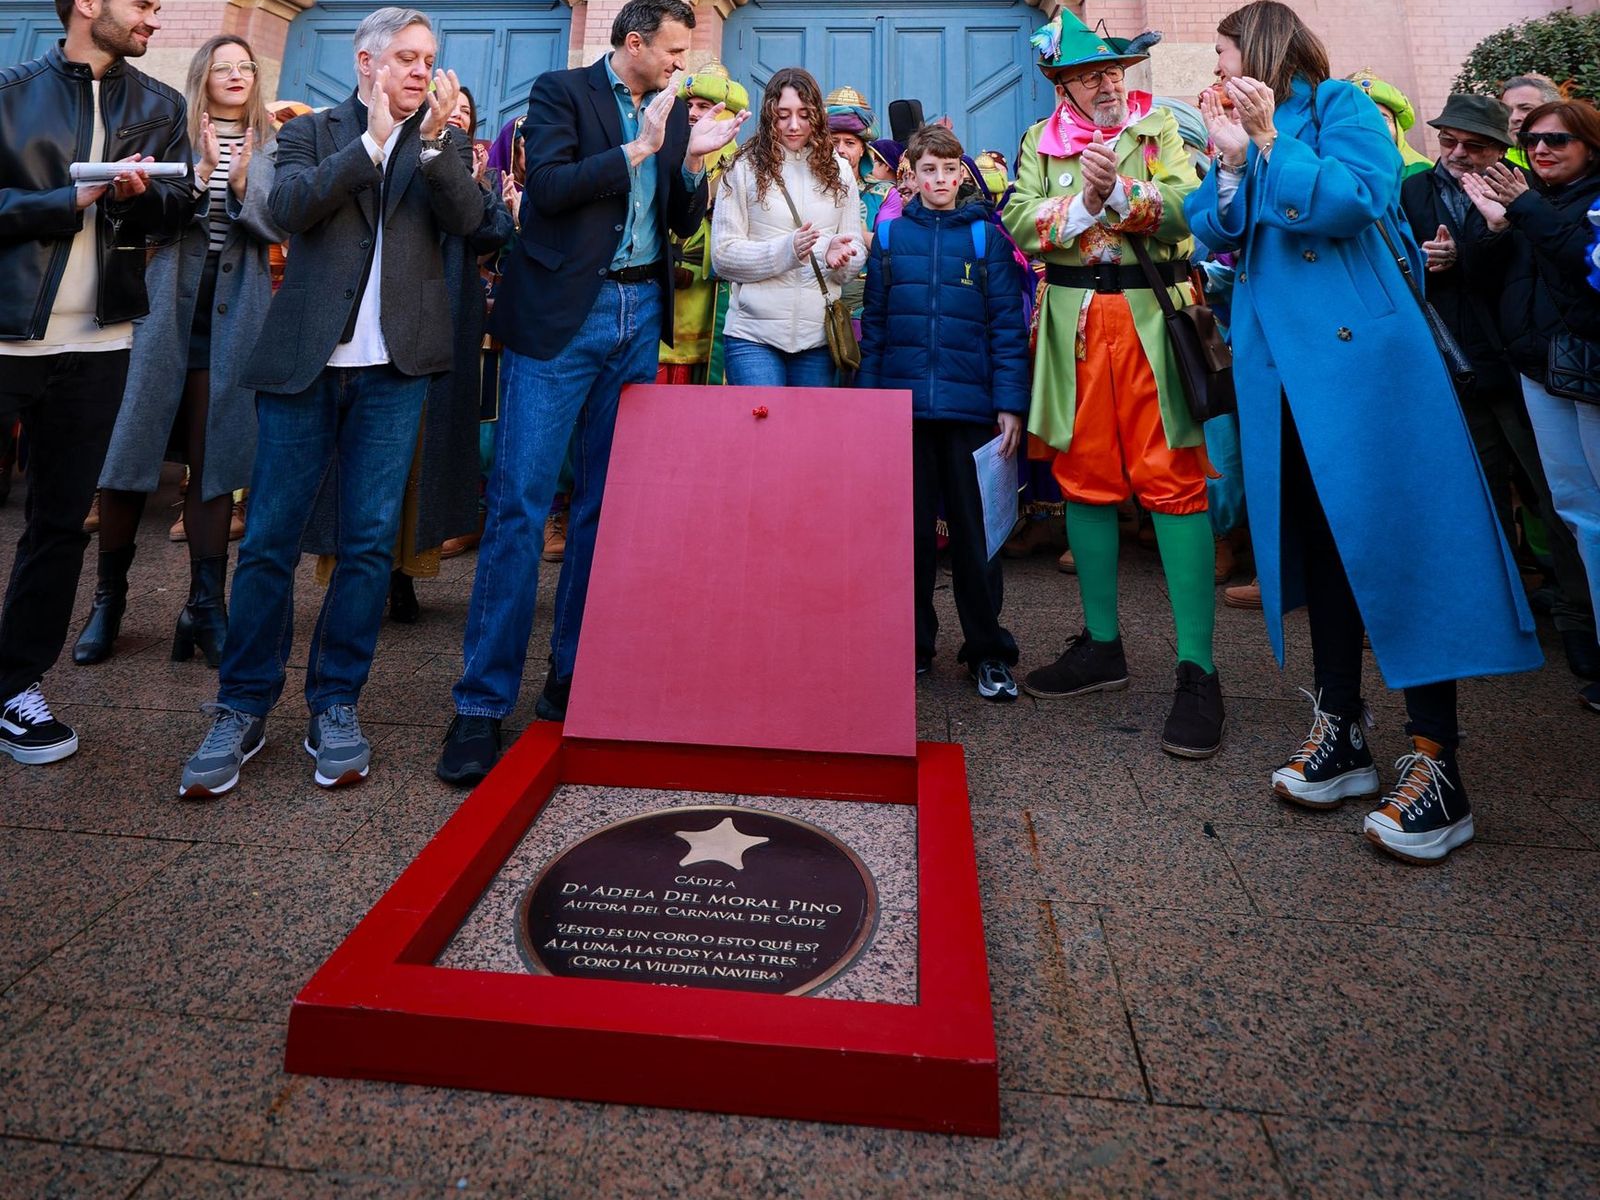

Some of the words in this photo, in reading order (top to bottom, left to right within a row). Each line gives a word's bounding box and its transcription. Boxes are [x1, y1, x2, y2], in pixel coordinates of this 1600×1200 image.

[674, 875, 723, 887] CÁDIZ
[725, 880, 737, 889] A
[591, 885, 655, 899] ADELA
[663, 890, 702, 903] DEL
[708, 894, 781, 909] MORAL
[788, 900, 842, 914] PINO
[563, 900, 628, 913] AUTORA
[665, 906, 745, 921] CARNAVAL
[750, 913, 771, 923] DE
[775, 915, 826, 929] CÁDIZ
[545, 938, 557, 948] A
[561, 940, 578, 950] LA
[621, 944, 632, 953] A
[635, 945, 664, 955] LAS
[666, 947, 700, 958] DOS
[728, 952, 756, 962] LAS
[607, 928, 625, 937] ES
[627, 929, 651, 939] UN
[653, 931, 699, 942] CORO
[701, 935, 715, 944] O
[718, 936, 756, 947] ESTO
[759, 939, 792, 950] QUÉ
[796, 942, 820, 953] ES?
[623, 958, 642, 970] LA
[645, 960, 708, 975] VIUDITA
